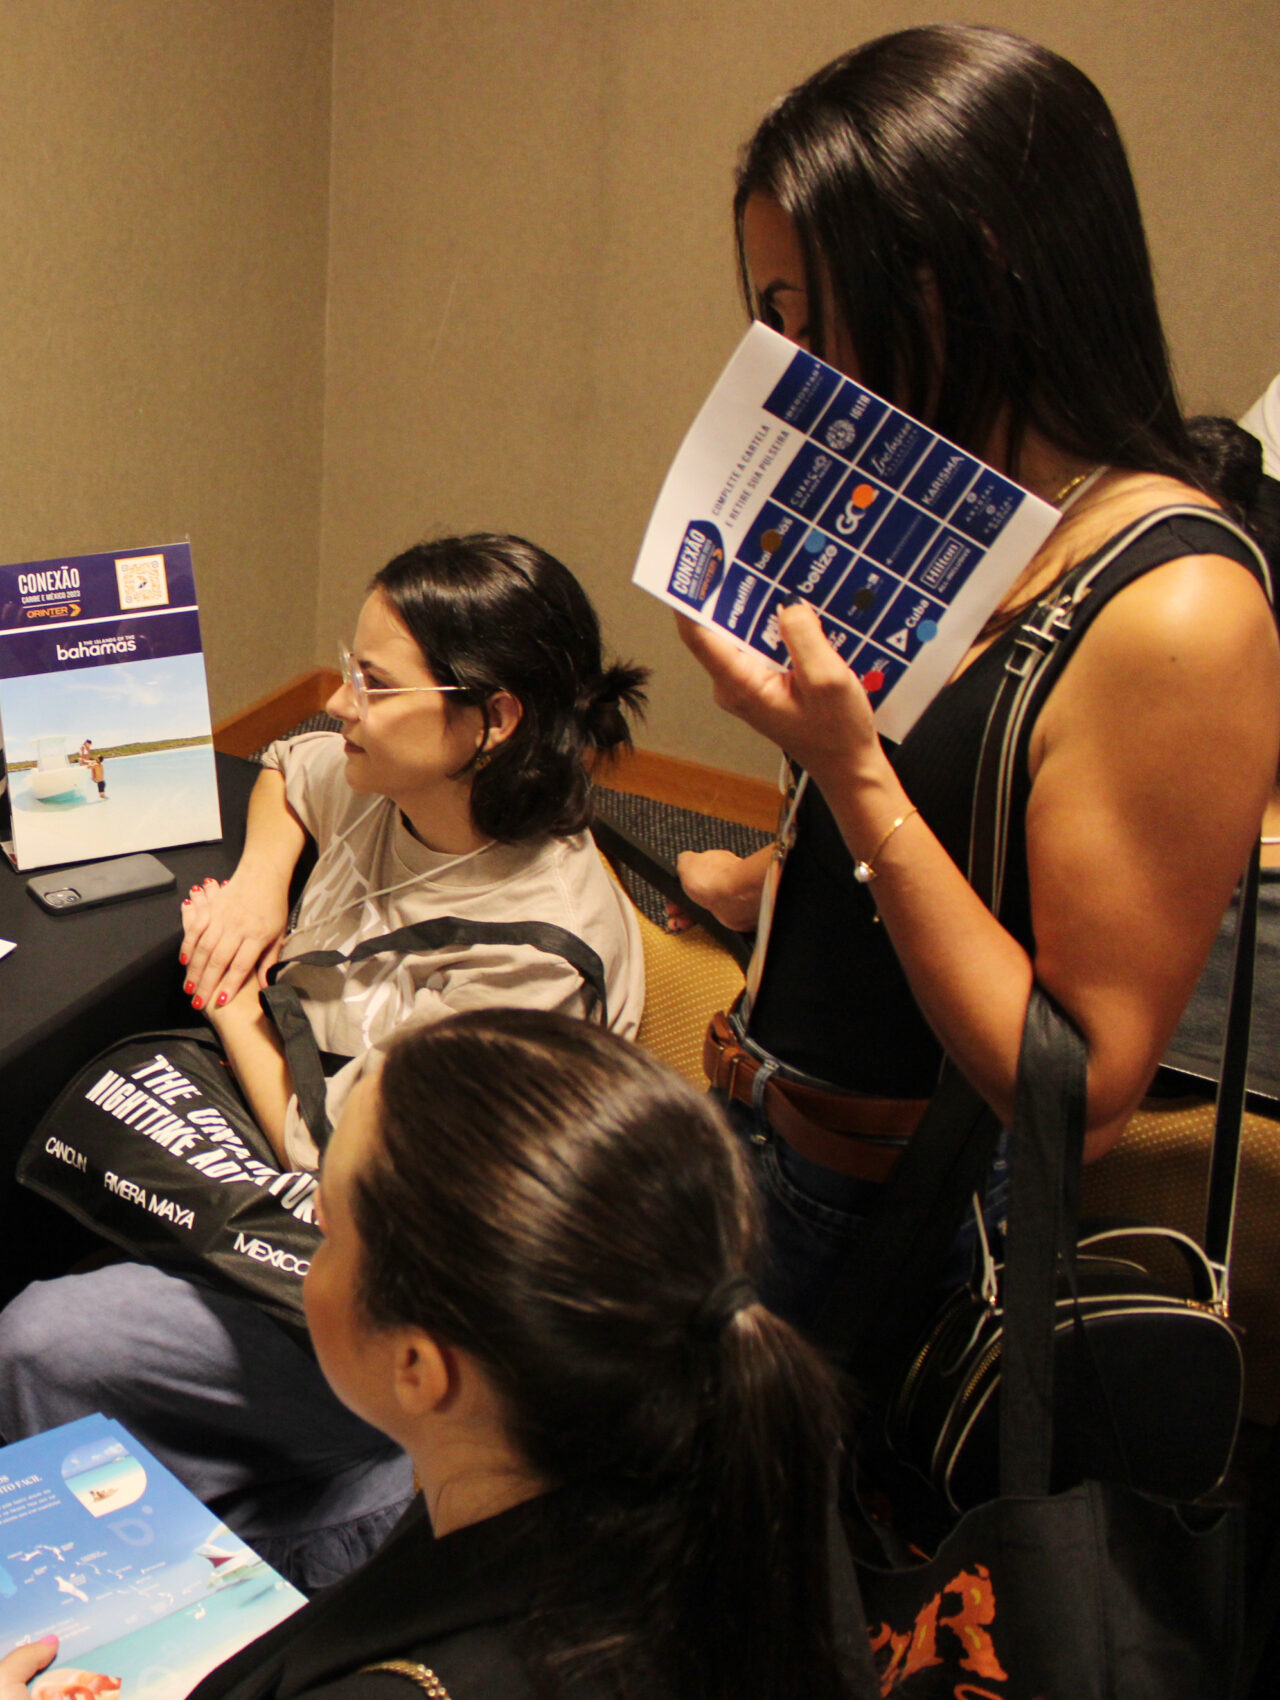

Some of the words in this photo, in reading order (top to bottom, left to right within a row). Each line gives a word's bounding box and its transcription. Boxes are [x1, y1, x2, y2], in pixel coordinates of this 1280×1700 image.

[711, 470, 741, 516] COMPLETE
[736, 462, 746, 471] A
[741, 424, 770, 463] CARTELA
[725, 520, 733, 528] E
[729, 488, 752, 520] RETIRE
[747, 471, 763, 489] SUA
[759, 429, 790, 471] PULSEIRA
[921, 455, 965, 505] KARISMA
[18, 565, 80, 594] CONEXÃO
[672, 528, 706, 595] CONEXÃO
[925, 544, 959, 583] Hilton
[26, 606, 69, 619] ORINTER
[905, 599, 930, 628] Cuba
[56, 640, 137, 661] bahamas
[131, 1054, 202, 1106] THE
[85, 1069, 204, 1157] NIGHTTIME
[148, 1194, 196, 1230] MAYA
[233, 1232, 312, 1276] MEXICO
